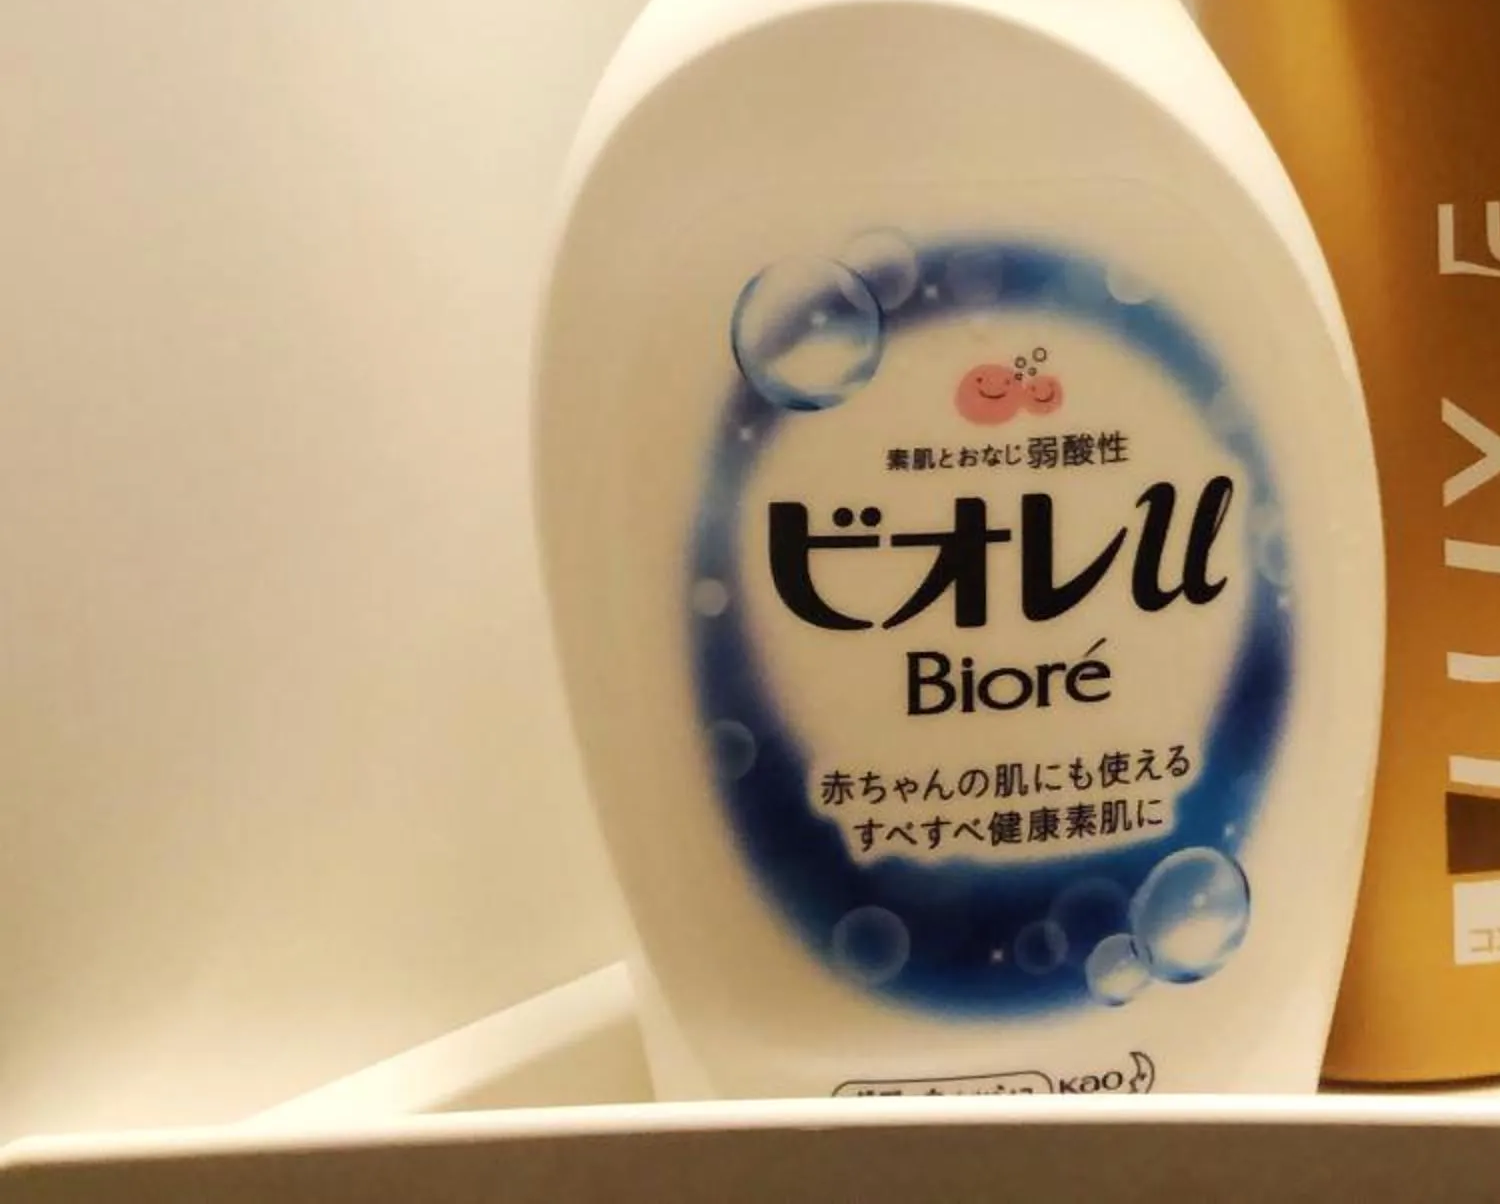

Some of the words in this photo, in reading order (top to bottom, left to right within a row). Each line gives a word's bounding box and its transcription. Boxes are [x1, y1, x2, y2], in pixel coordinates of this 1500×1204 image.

[886, 430, 1130, 472] 素肌とおなじ弱酸性
[906, 638, 1112, 716] Bioré
[820, 744, 1192, 806] 赤ちゃんの肌にも使える
[853, 799, 1164, 852] すべすべ健康素肌に
